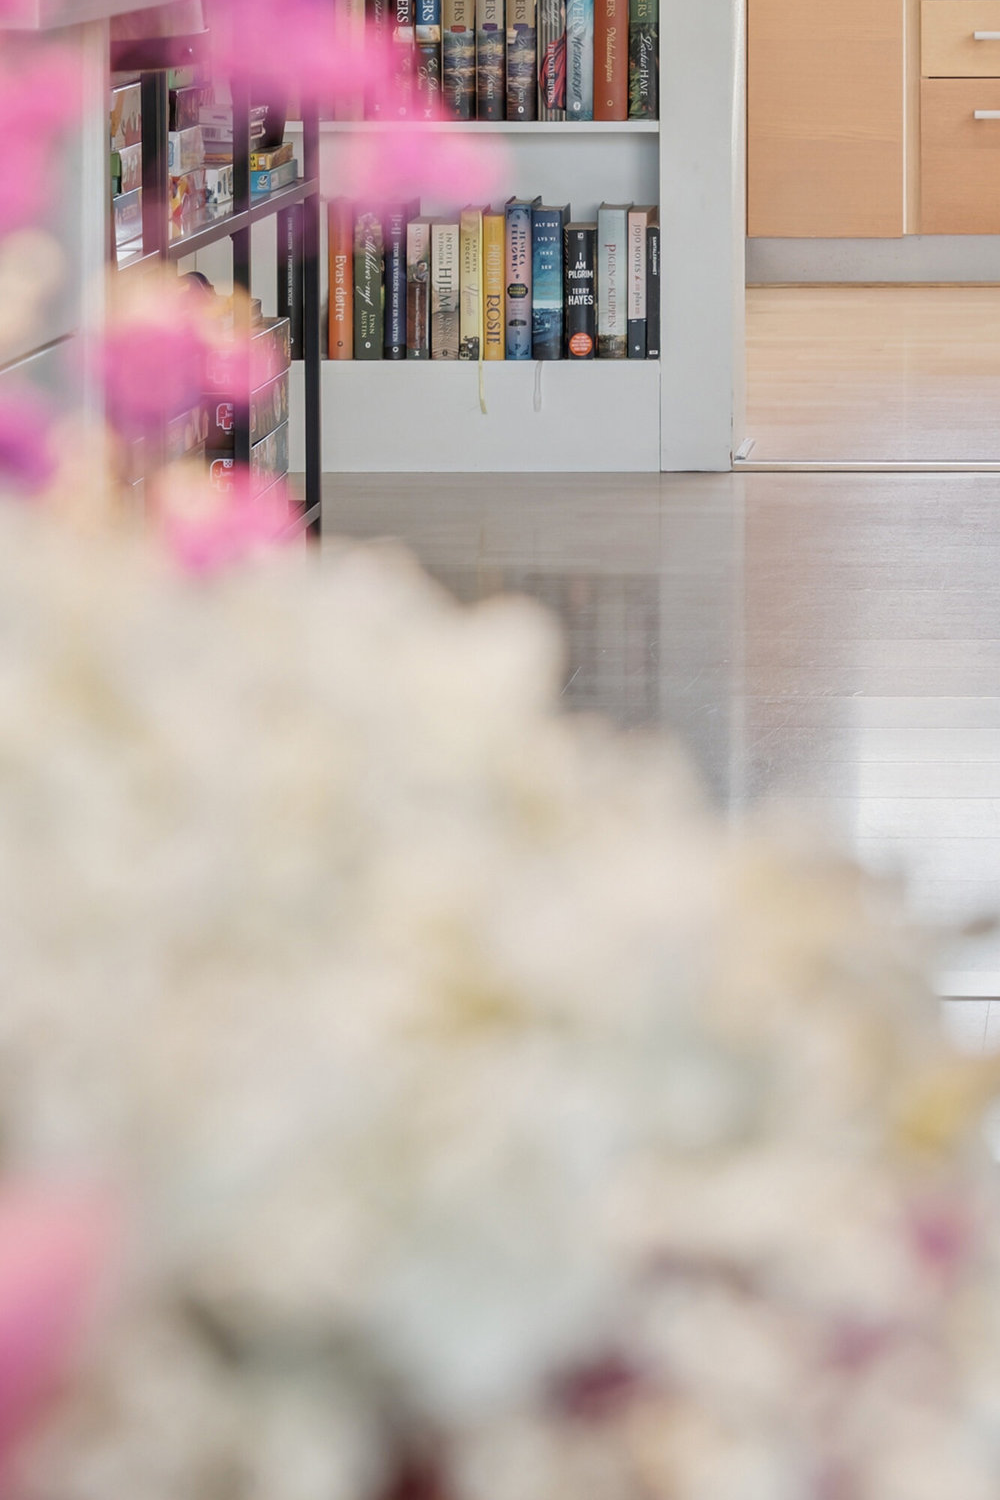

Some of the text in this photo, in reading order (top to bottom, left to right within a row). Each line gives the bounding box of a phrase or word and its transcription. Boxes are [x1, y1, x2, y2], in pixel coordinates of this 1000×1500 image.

[547, 43, 556, 104] FRANCINE RIVERS
[640, 69, 649, 97] HAVE
[392, 242, 400, 258] STOR
[446, 232, 454, 263] INDTIL
[578, 252, 582, 260] I
[633, 225, 642, 273] JOJO MOYES
[364, 252, 379, 280] bliver
[392, 258, 400, 267] ER
[568, 270, 594, 279] PILGRIM
[575, 261, 587, 270] AM
[335, 254, 348, 321] Evas døtre
[392, 267, 400, 292] VERDEN
[436, 267, 453, 308] HJEM
[572, 287, 589, 295] TERRY
[604, 244, 617, 329] PIGEN KLIPPEN
[355, 282, 374, 307] nyt
[392, 292, 400, 308] SORT
[486, 244, 501, 345] PROJEKT ROSIE
[568, 295, 594, 305] HAYES
[360, 309, 368, 338] AUSTIN
[392, 308, 400, 318] ER
[392, 318, 400, 342] NATTEN
